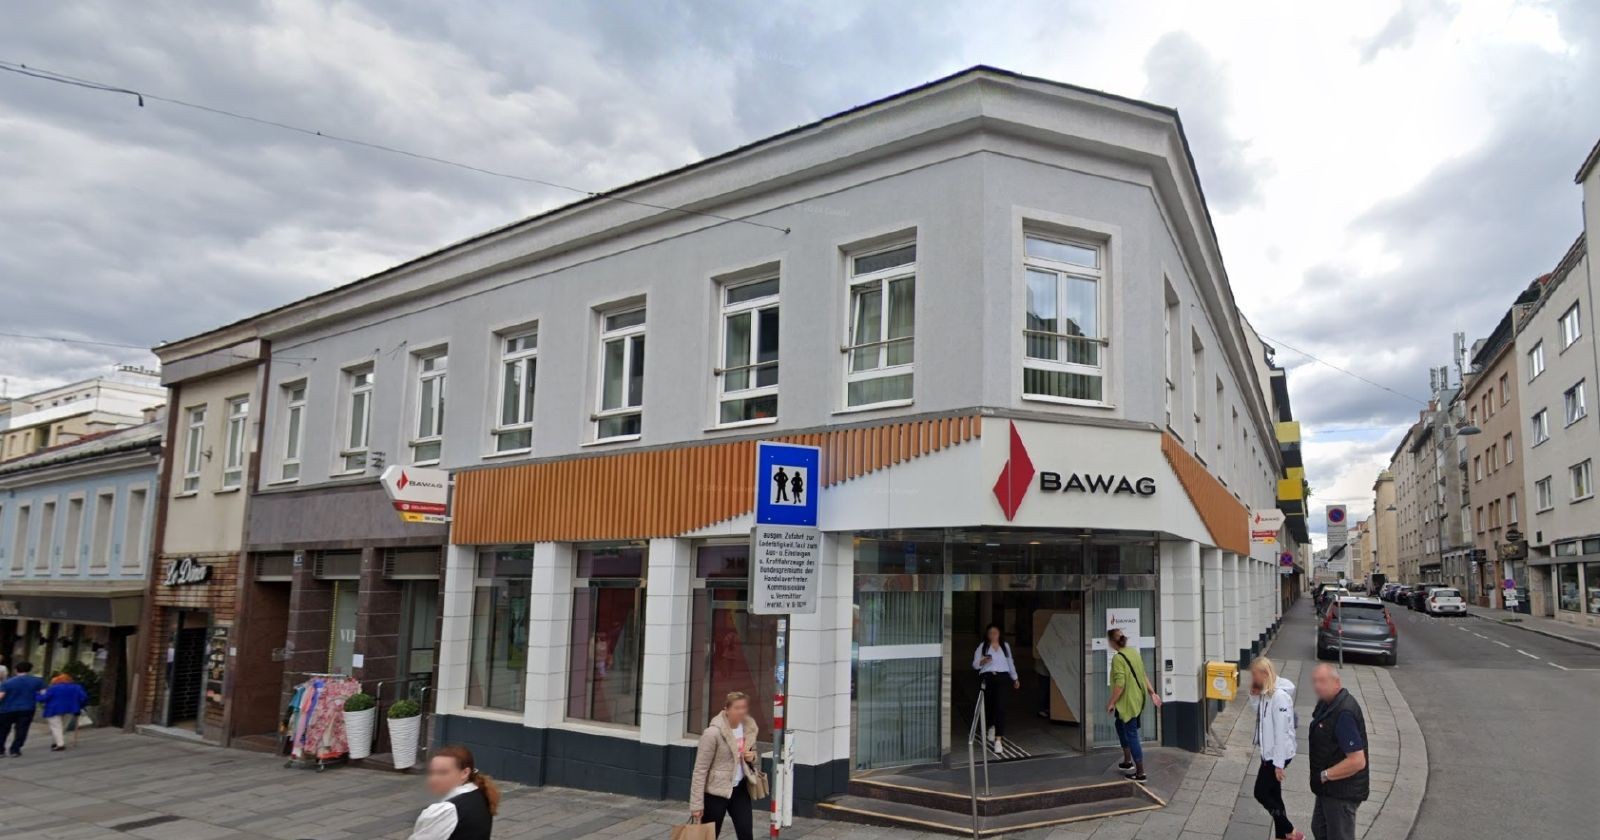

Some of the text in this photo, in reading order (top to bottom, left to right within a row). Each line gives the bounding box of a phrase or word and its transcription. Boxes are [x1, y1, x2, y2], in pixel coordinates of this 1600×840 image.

[408, 480, 443, 488] BAWAG
[1040, 471, 1156, 496] BAWAG
[784, 532, 804, 540] Zufahrt
[784, 549, 811, 558] Einsteigen
[766, 557, 805, 567] Kraftfahrzeuge
[775, 592, 802, 600] Vermittler
